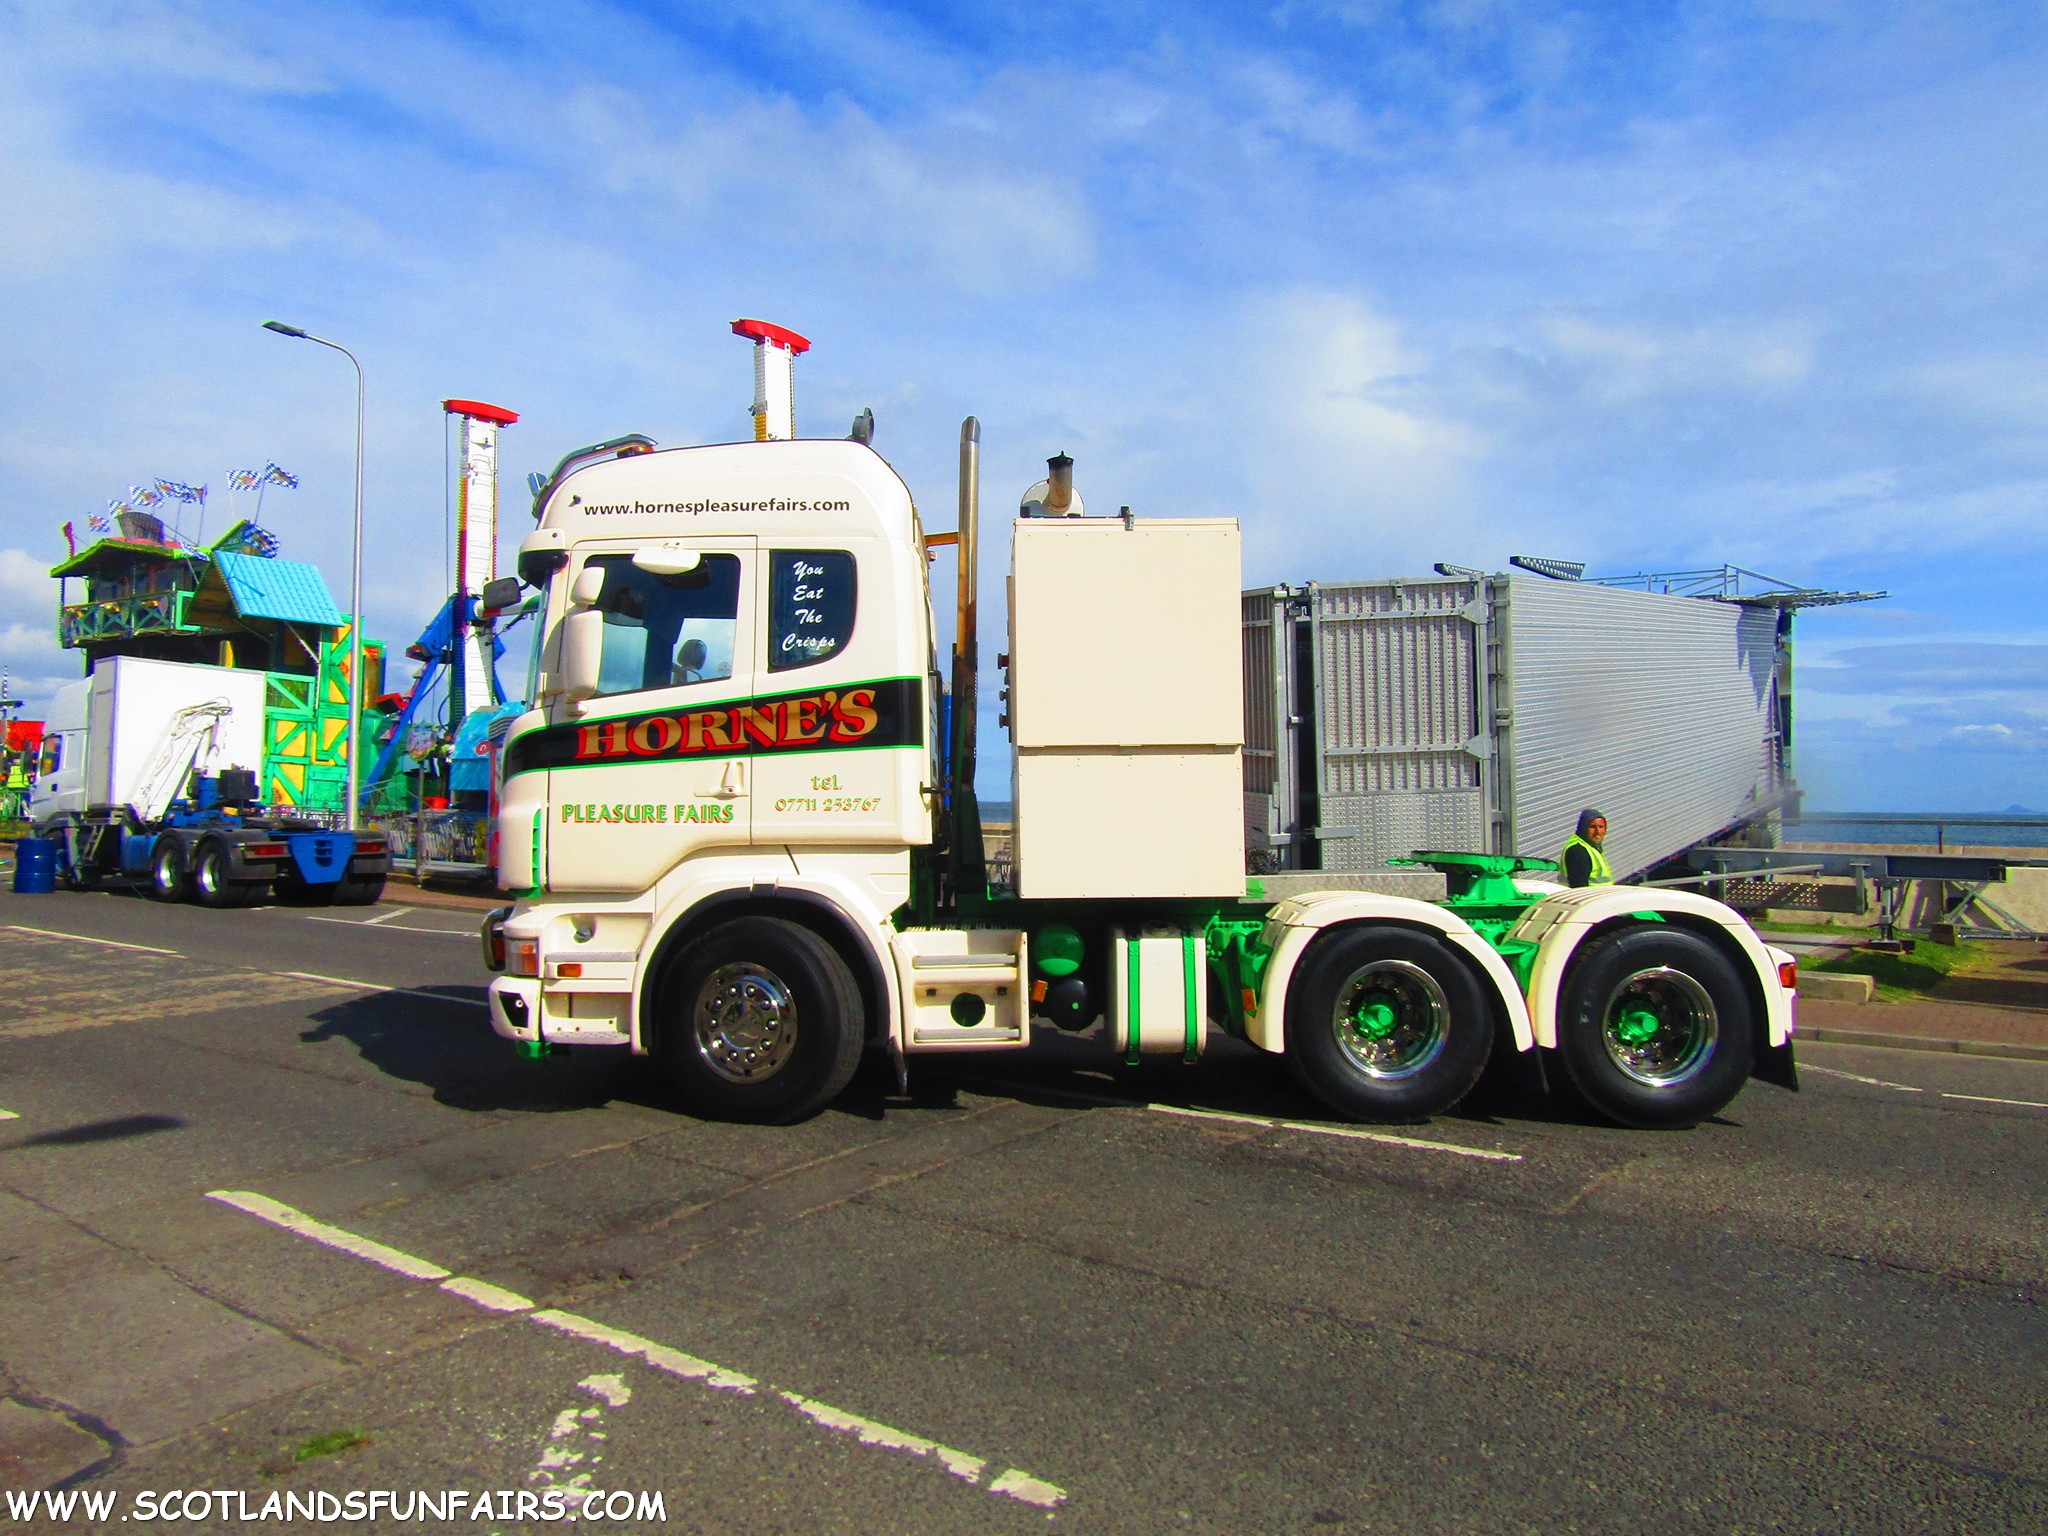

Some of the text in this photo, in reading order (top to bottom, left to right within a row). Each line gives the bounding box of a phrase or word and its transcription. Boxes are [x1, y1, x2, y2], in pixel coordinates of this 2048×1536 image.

[584, 498, 850, 516] www.hornespleasurefairs.com
[792, 561, 824, 582] You
[792, 584, 824, 601] Eat
[794, 608, 823, 625] The
[781, 633, 836, 652] Crisps
[575, 689, 879, 759] HORNE'S
[810, 774, 843, 791] tel.
[774, 797, 881, 812] 07711 253767
[561, 804, 734, 824] PLEASURE FAIRS
